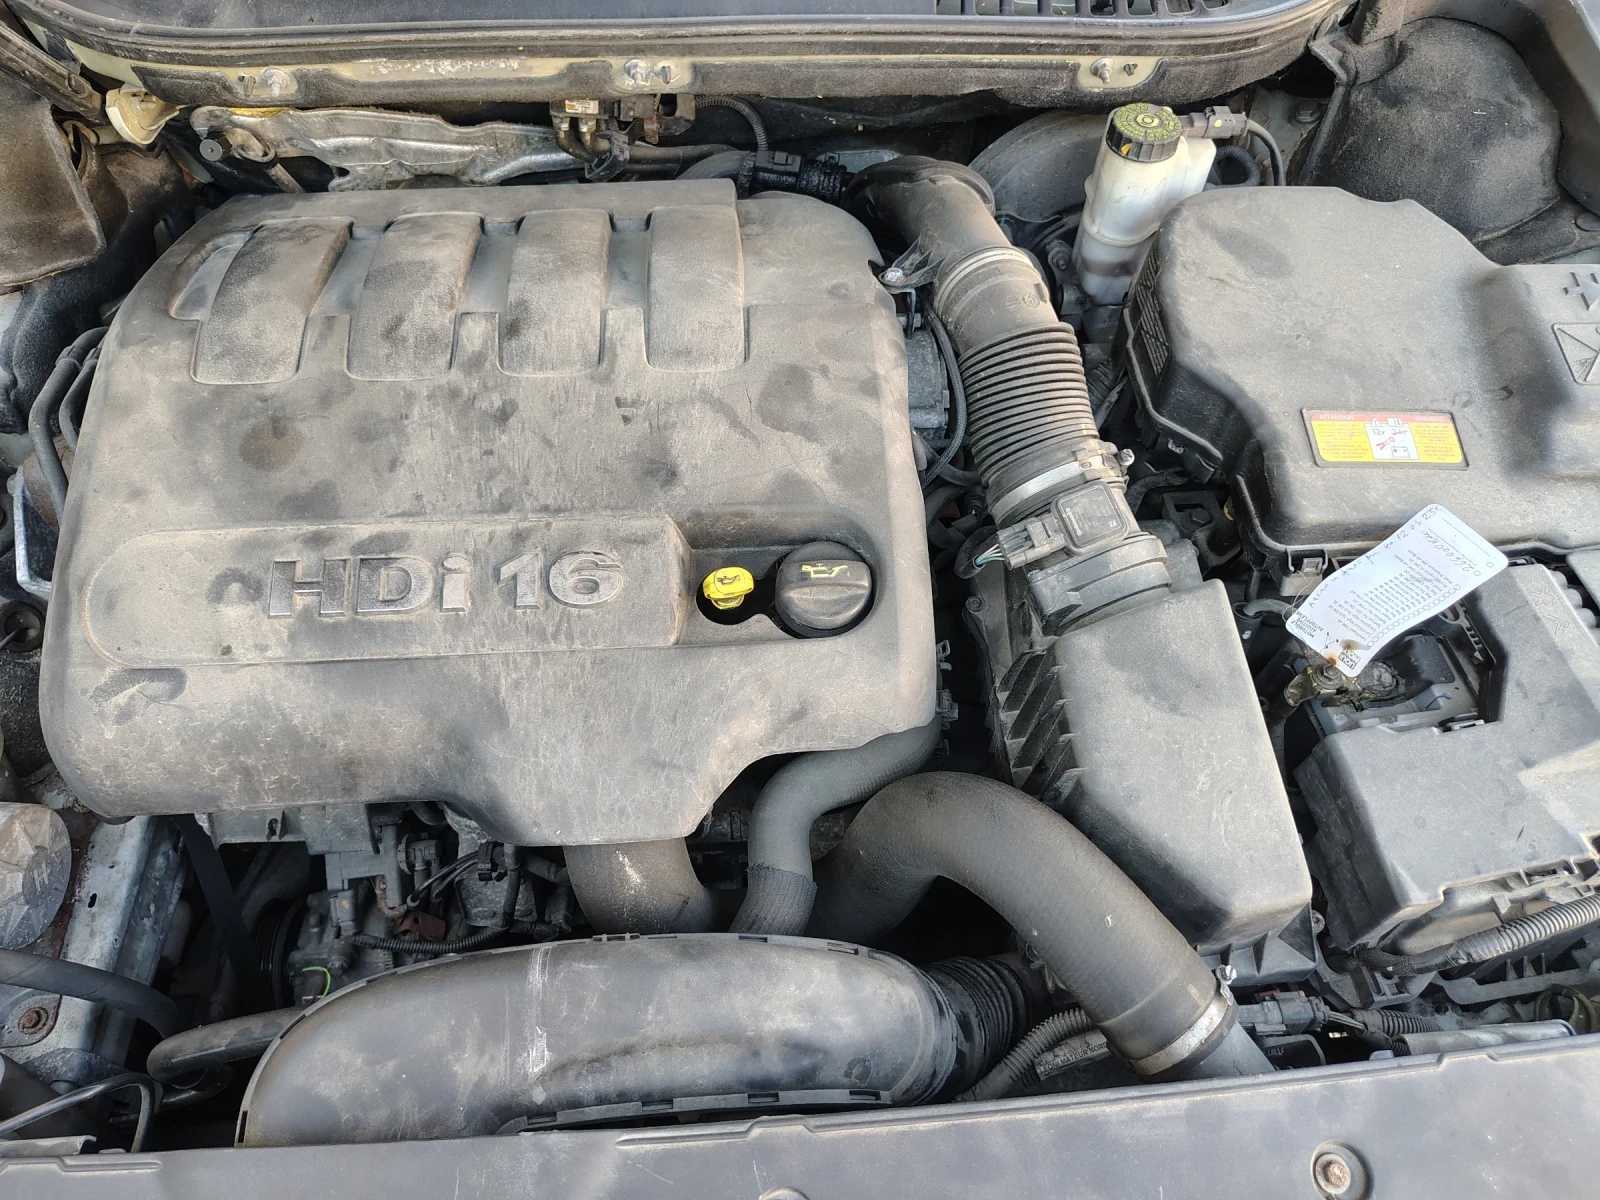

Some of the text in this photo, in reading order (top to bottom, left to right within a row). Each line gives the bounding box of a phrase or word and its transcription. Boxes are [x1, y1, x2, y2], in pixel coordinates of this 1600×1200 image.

[269, 549, 624, 617] HDi 16
[1338, 653, 1356, 668] LIQUI
[1340, 647, 1361, 663] MOLY
[1060, 1049, 1088, 1064] MATEUR
